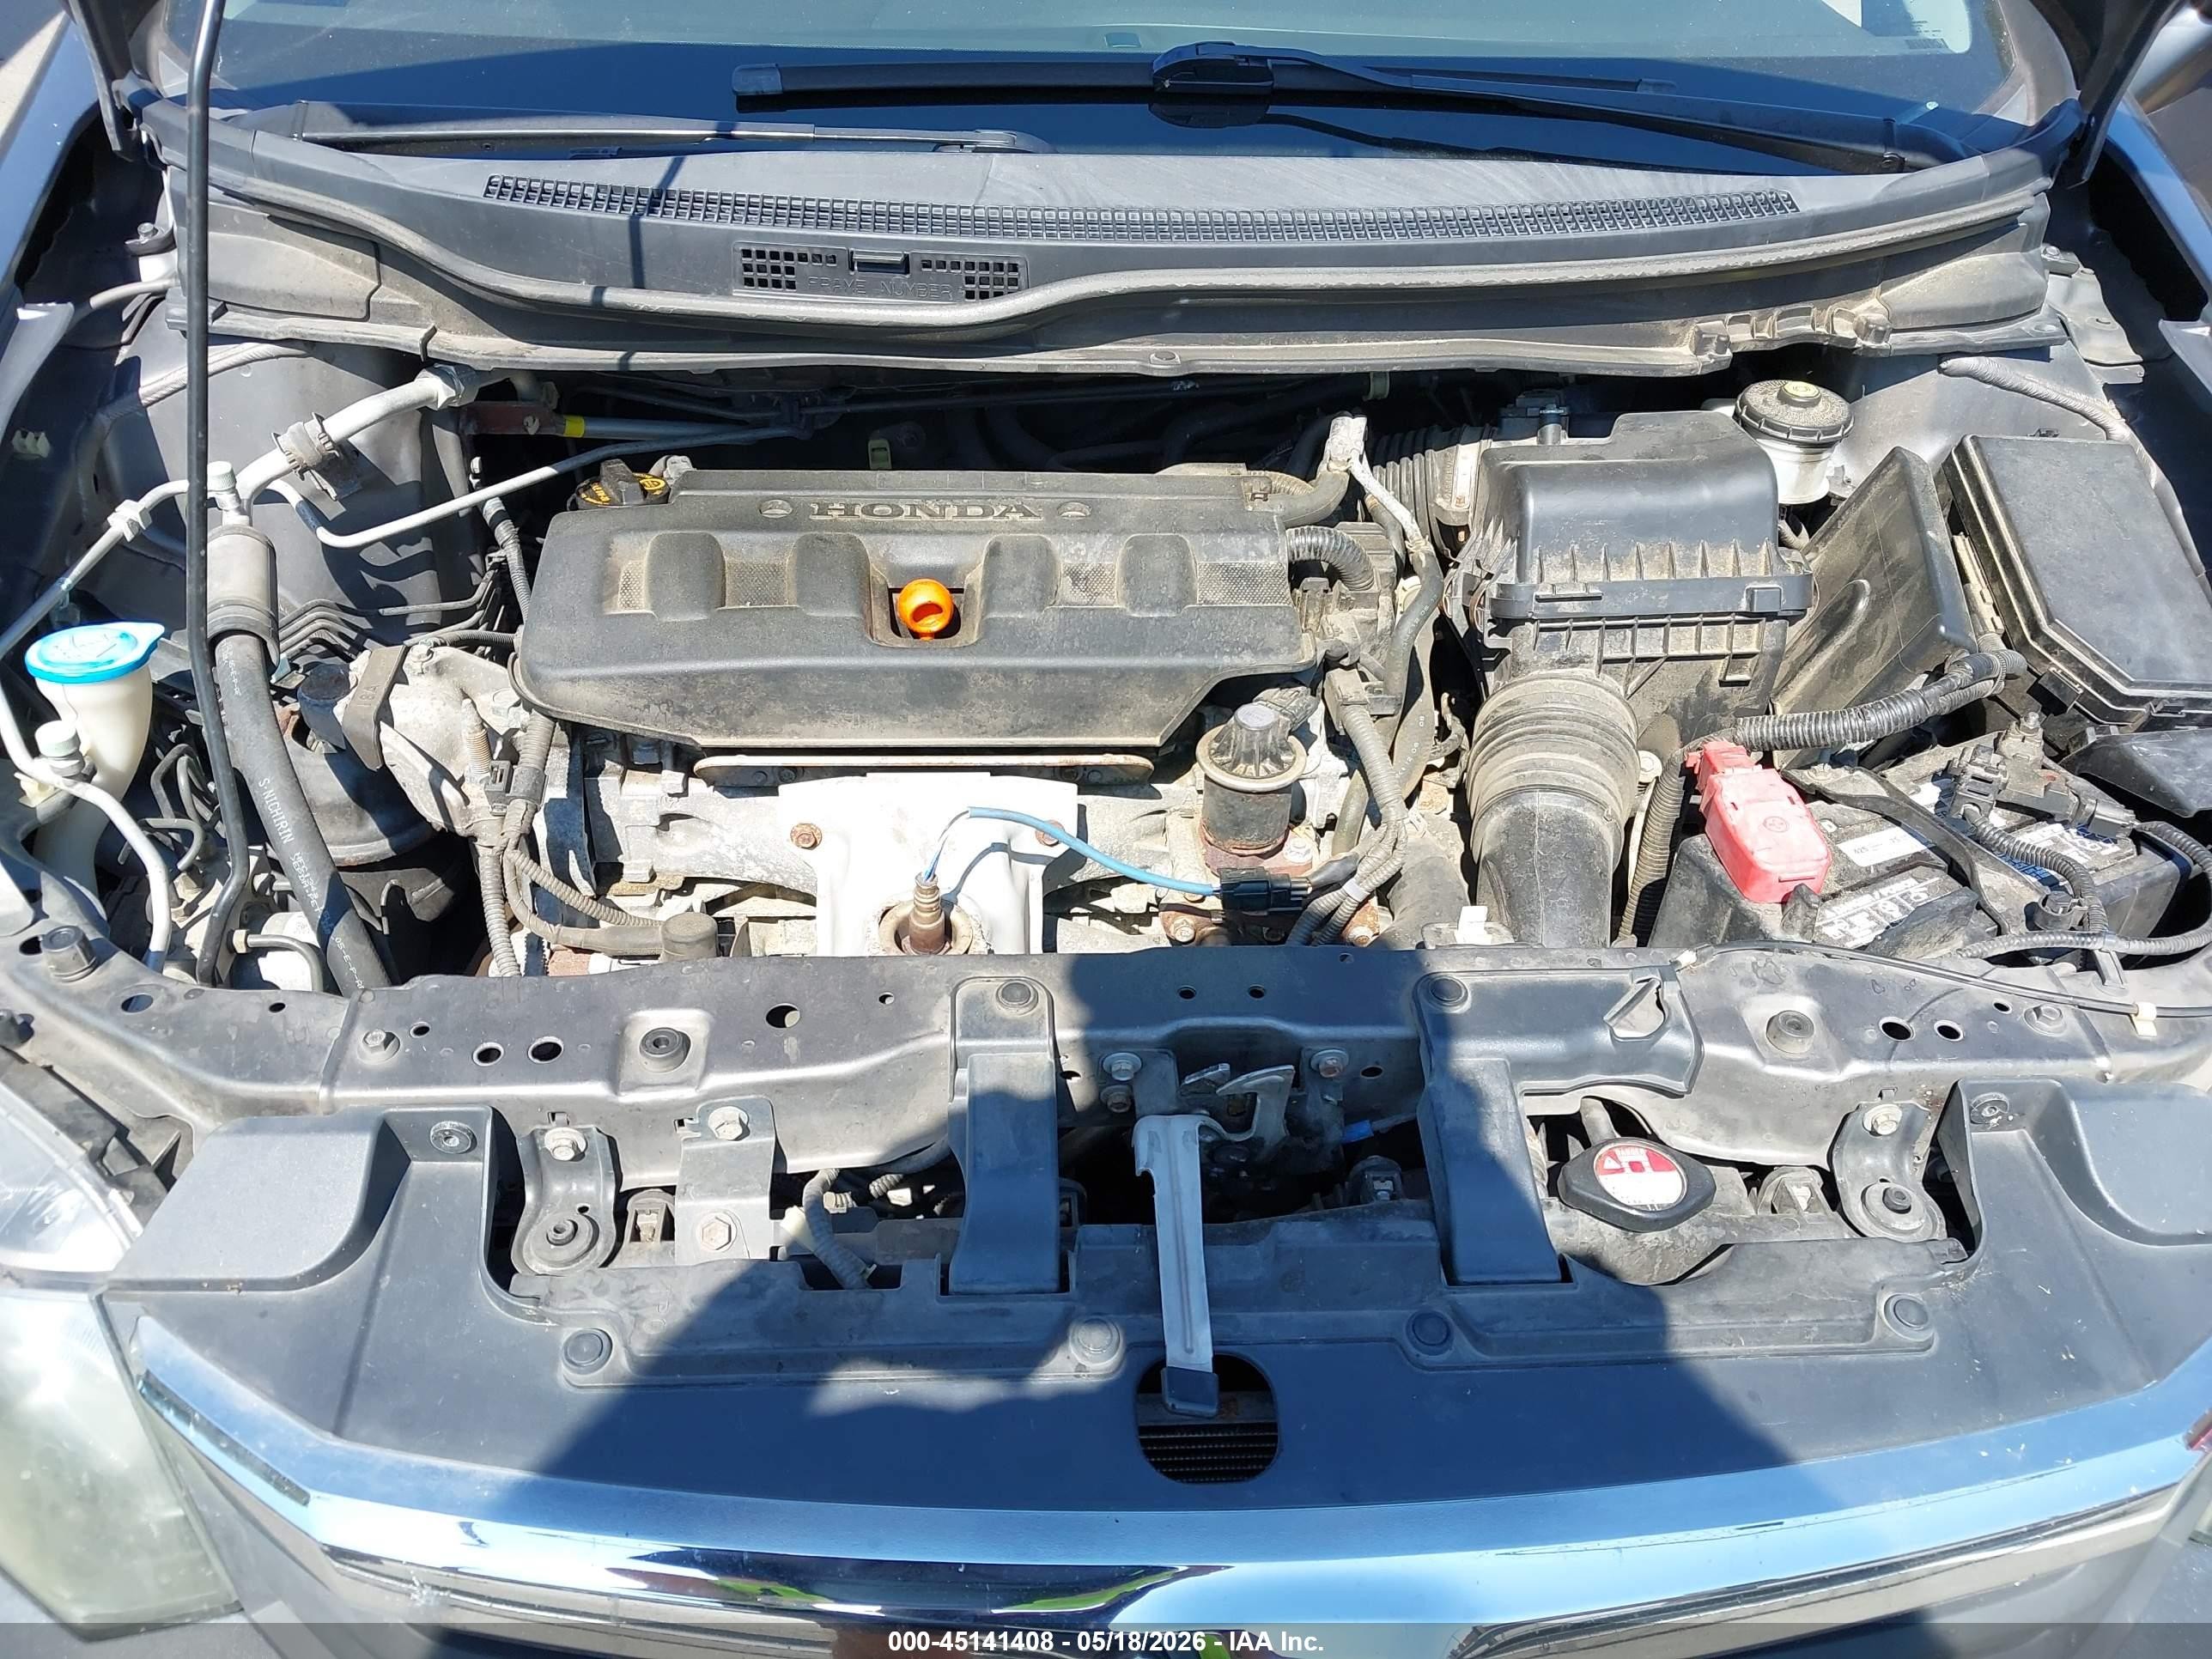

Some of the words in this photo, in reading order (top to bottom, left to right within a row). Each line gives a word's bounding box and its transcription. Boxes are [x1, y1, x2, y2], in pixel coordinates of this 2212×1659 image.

[808, 276, 866, 294] FRAME
[880, 279, 953, 301] NUMBER
[810, 501, 1042, 520] HONDA
